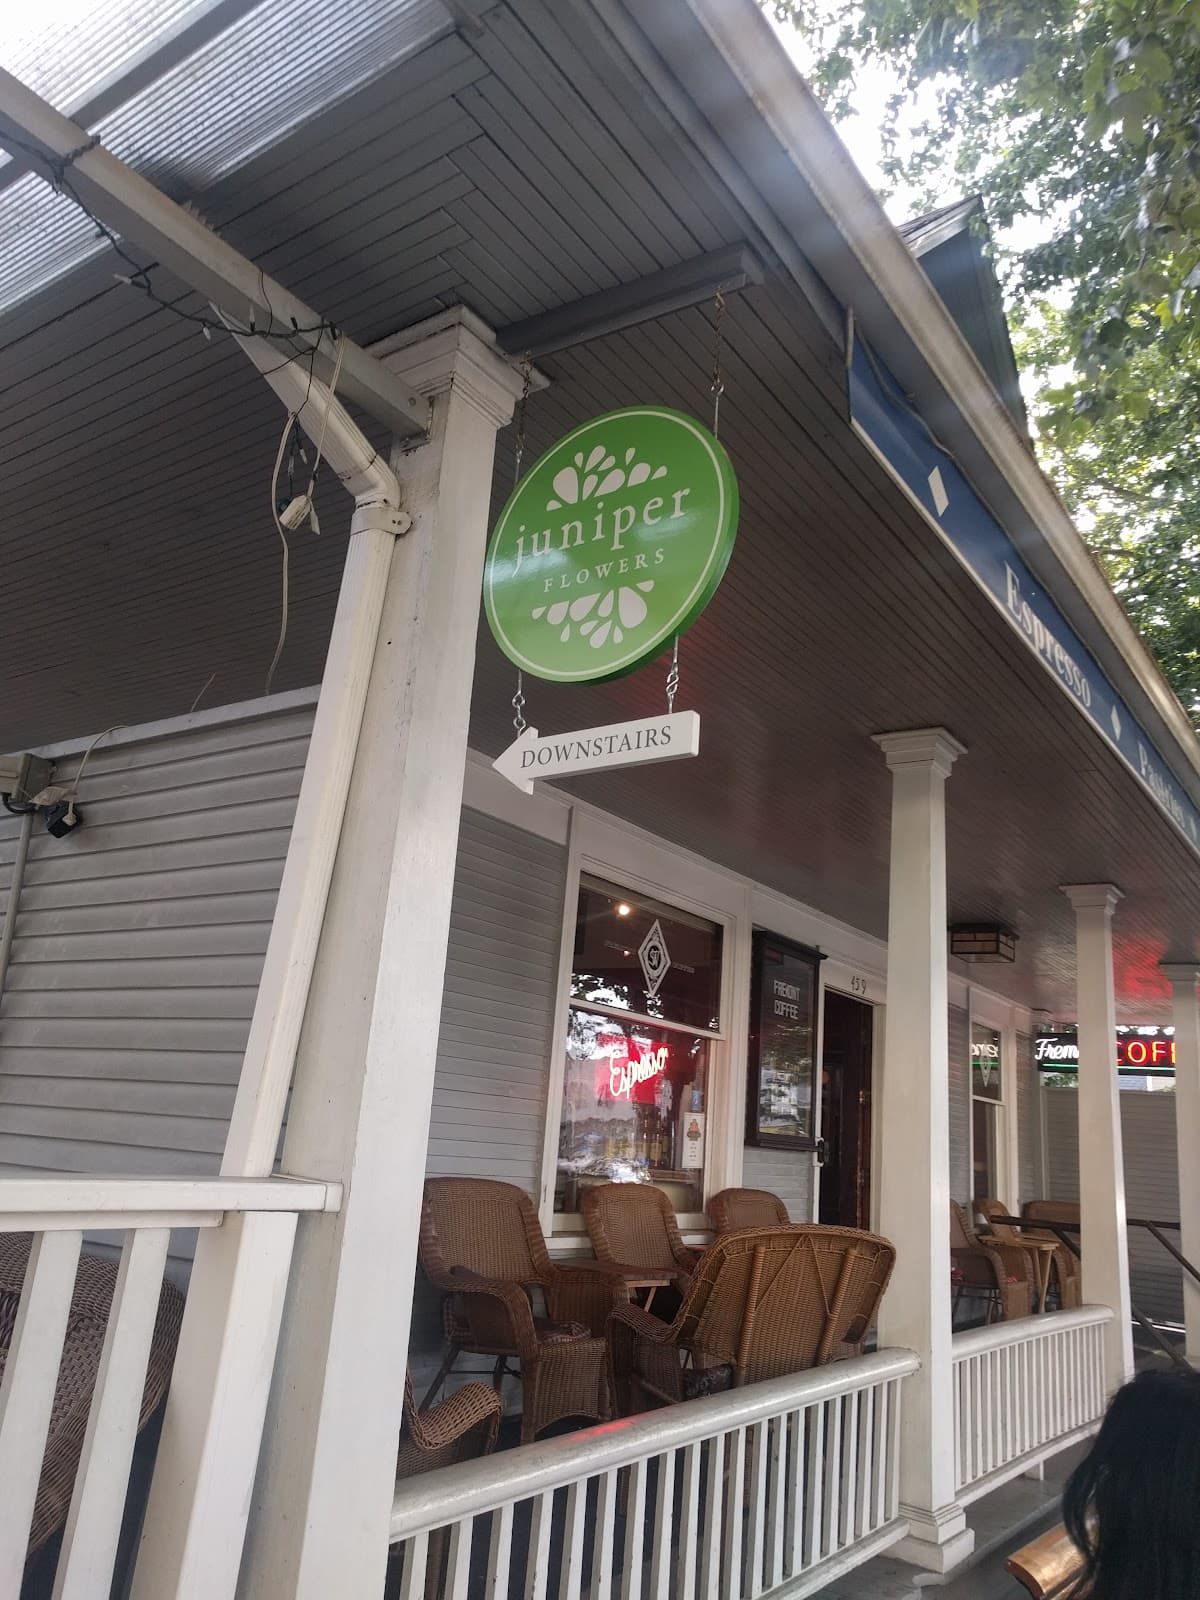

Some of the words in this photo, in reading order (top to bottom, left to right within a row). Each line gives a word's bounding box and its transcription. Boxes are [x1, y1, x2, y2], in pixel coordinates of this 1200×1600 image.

[513, 488, 691, 576] juniper
[543, 548, 666, 593] FLOWERS
[1004, 560, 1091, 707] Espresso
[520, 725, 673, 770] DOWNSTAIRS
[774, 999, 799, 1020] COFFEE
[609, 1047, 669, 1099] Espresso
